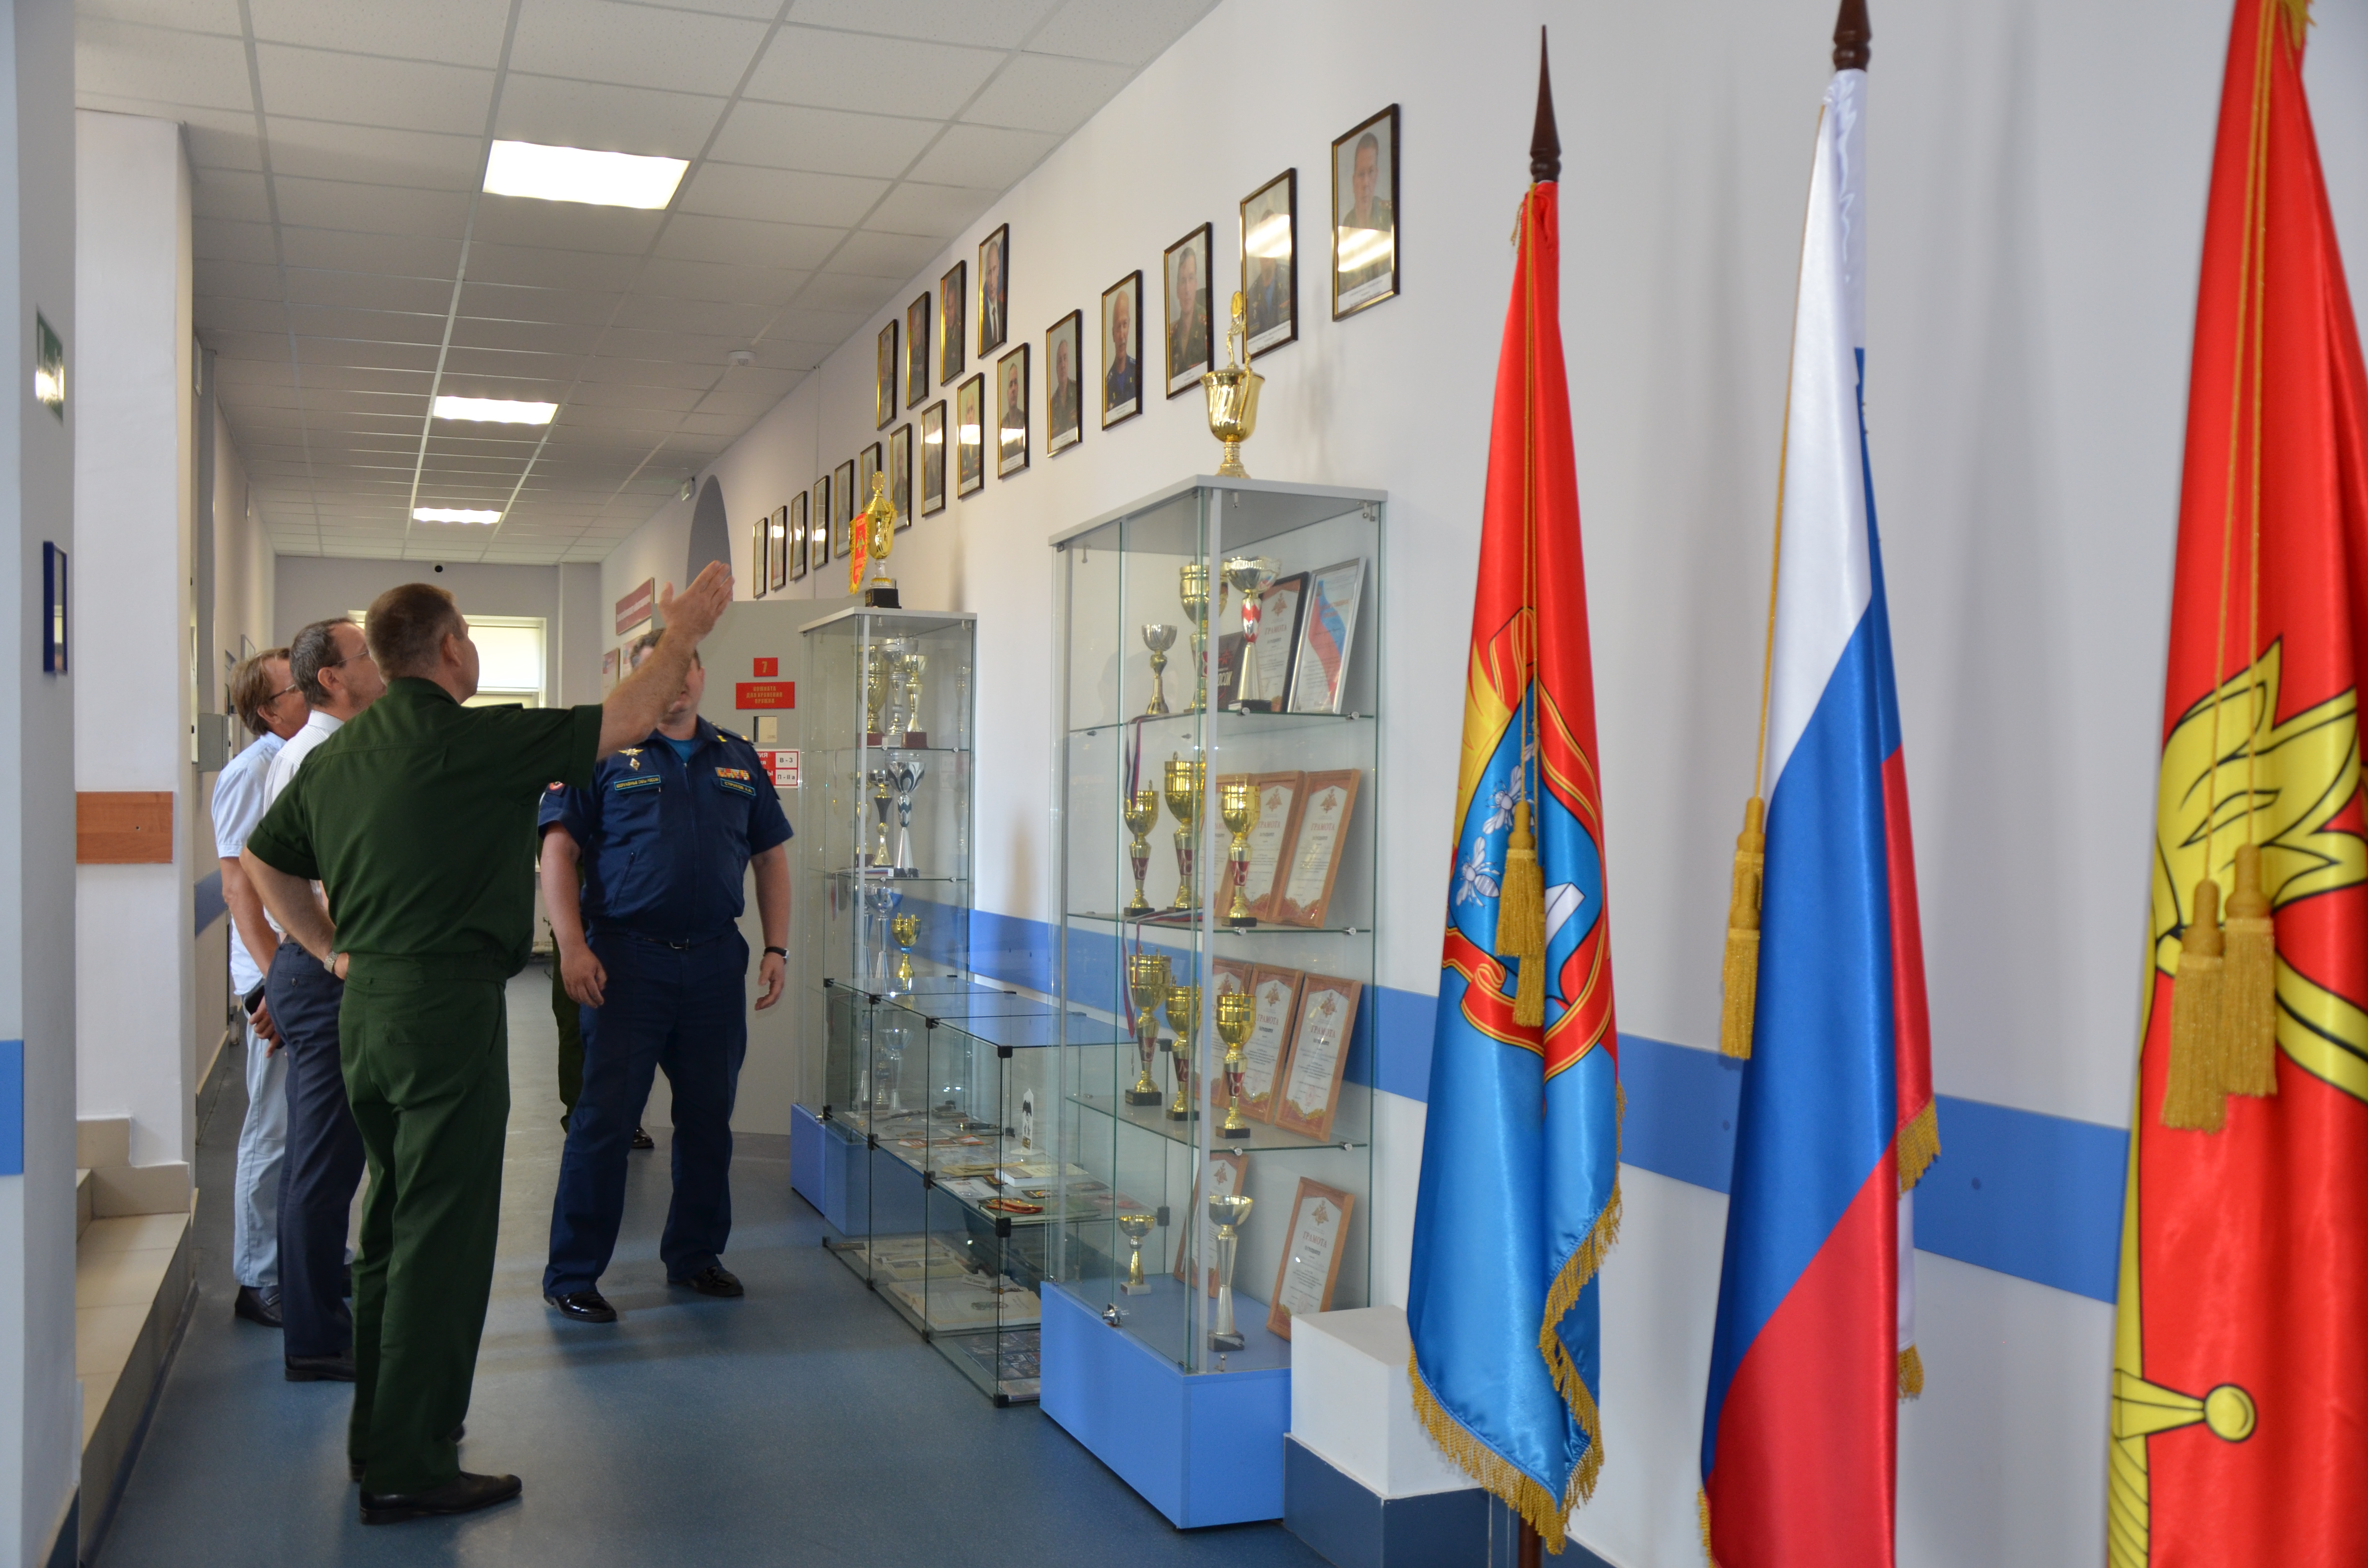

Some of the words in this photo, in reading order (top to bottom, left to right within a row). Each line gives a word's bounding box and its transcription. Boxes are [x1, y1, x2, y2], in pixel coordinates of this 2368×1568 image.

[1265, 624, 1287, 635] ГРАМОТА
[762, 661, 767, 673] 7
[1257, 1014, 1279, 1025] ГРАМОТА
[1311, 1025, 1336, 1038] ГРАМОТА
[1303, 1231, 1327, 1248] ГРАМОТА
